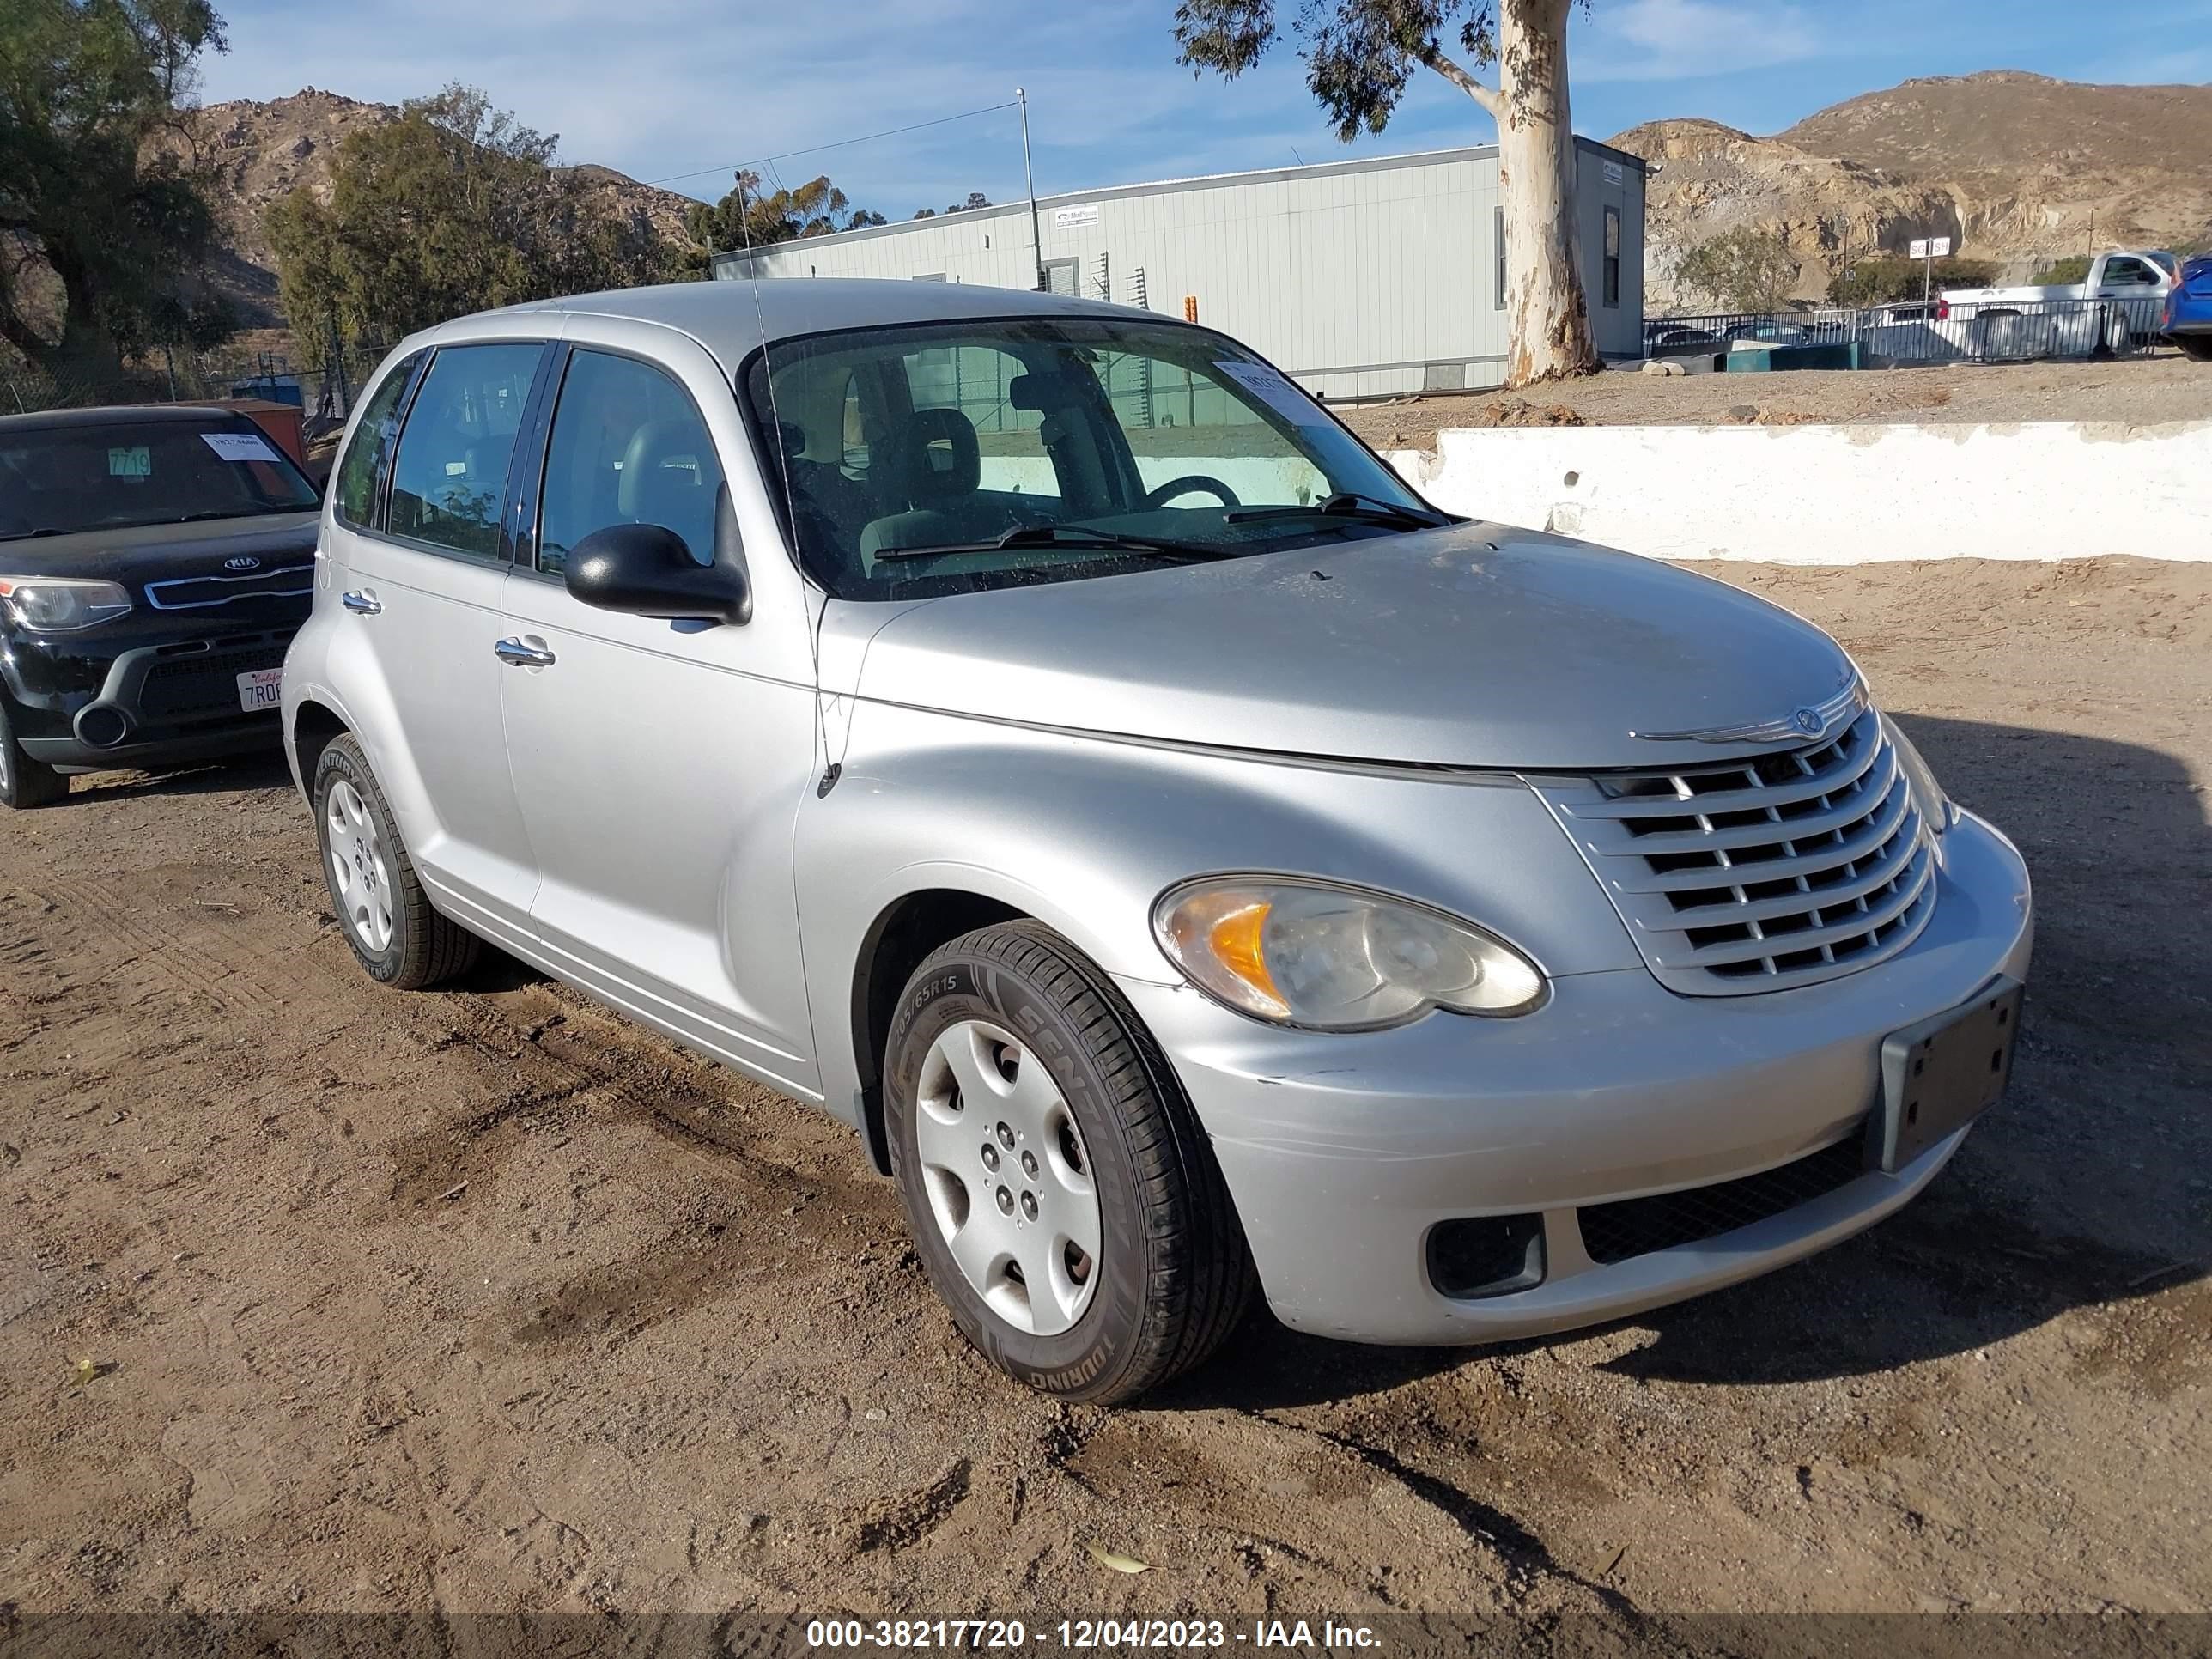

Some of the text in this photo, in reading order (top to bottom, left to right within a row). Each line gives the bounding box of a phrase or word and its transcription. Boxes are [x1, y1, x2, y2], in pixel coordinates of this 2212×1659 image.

[1911, 244, 1925, 255] SG
[1934, 241, 1948, 252] SH
[110, 453, 149, 475] 7719
[229, 557, 256, 568] KIA
[895, 975, 957, 1045] 205/65R15
[1028, 1333, 1117, 1391] TOURING
